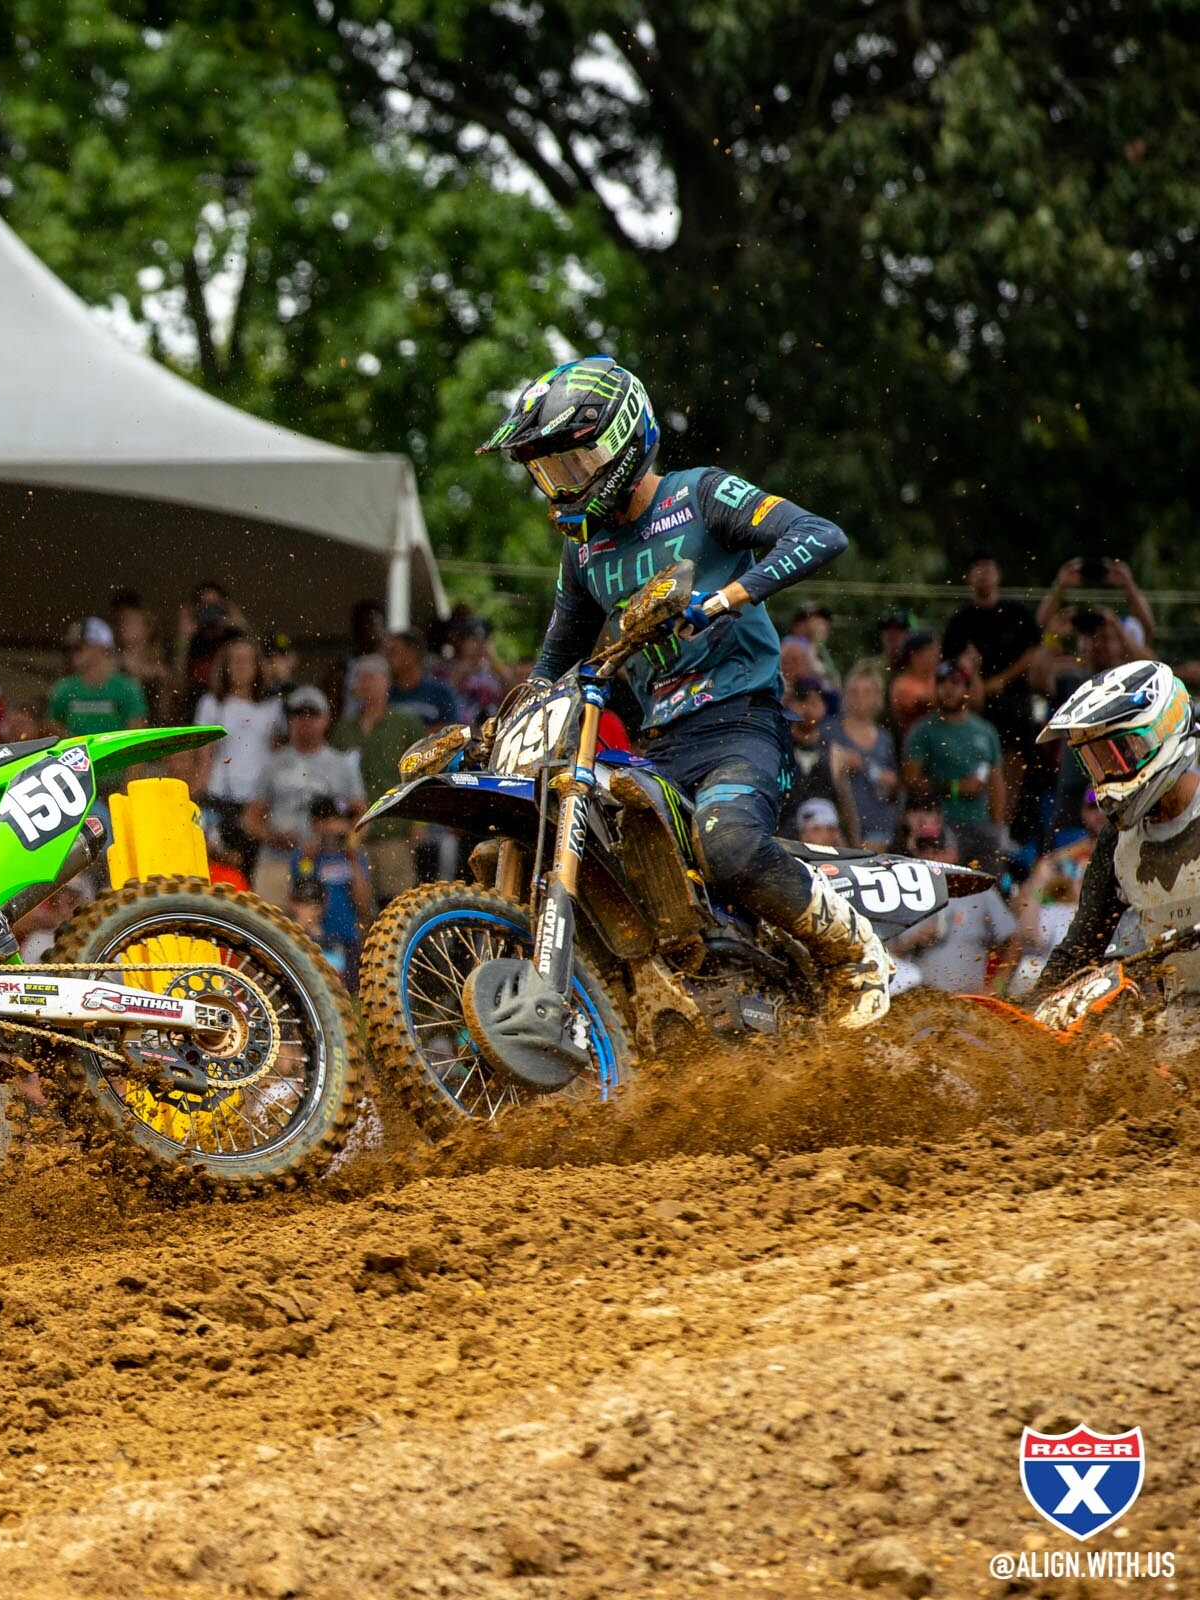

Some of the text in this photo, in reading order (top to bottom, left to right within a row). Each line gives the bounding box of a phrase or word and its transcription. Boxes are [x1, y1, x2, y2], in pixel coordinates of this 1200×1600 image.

[600, 446, 637, 499] MONSTER
[651, 507, 694, 535] YAMAHA
[850, 862, 937, 913] 59
[1169, 905, 1192, 920] FOX
[538, 897, 558, 975] DUNLOP
[24, 984, 58, 993] EXCEL
